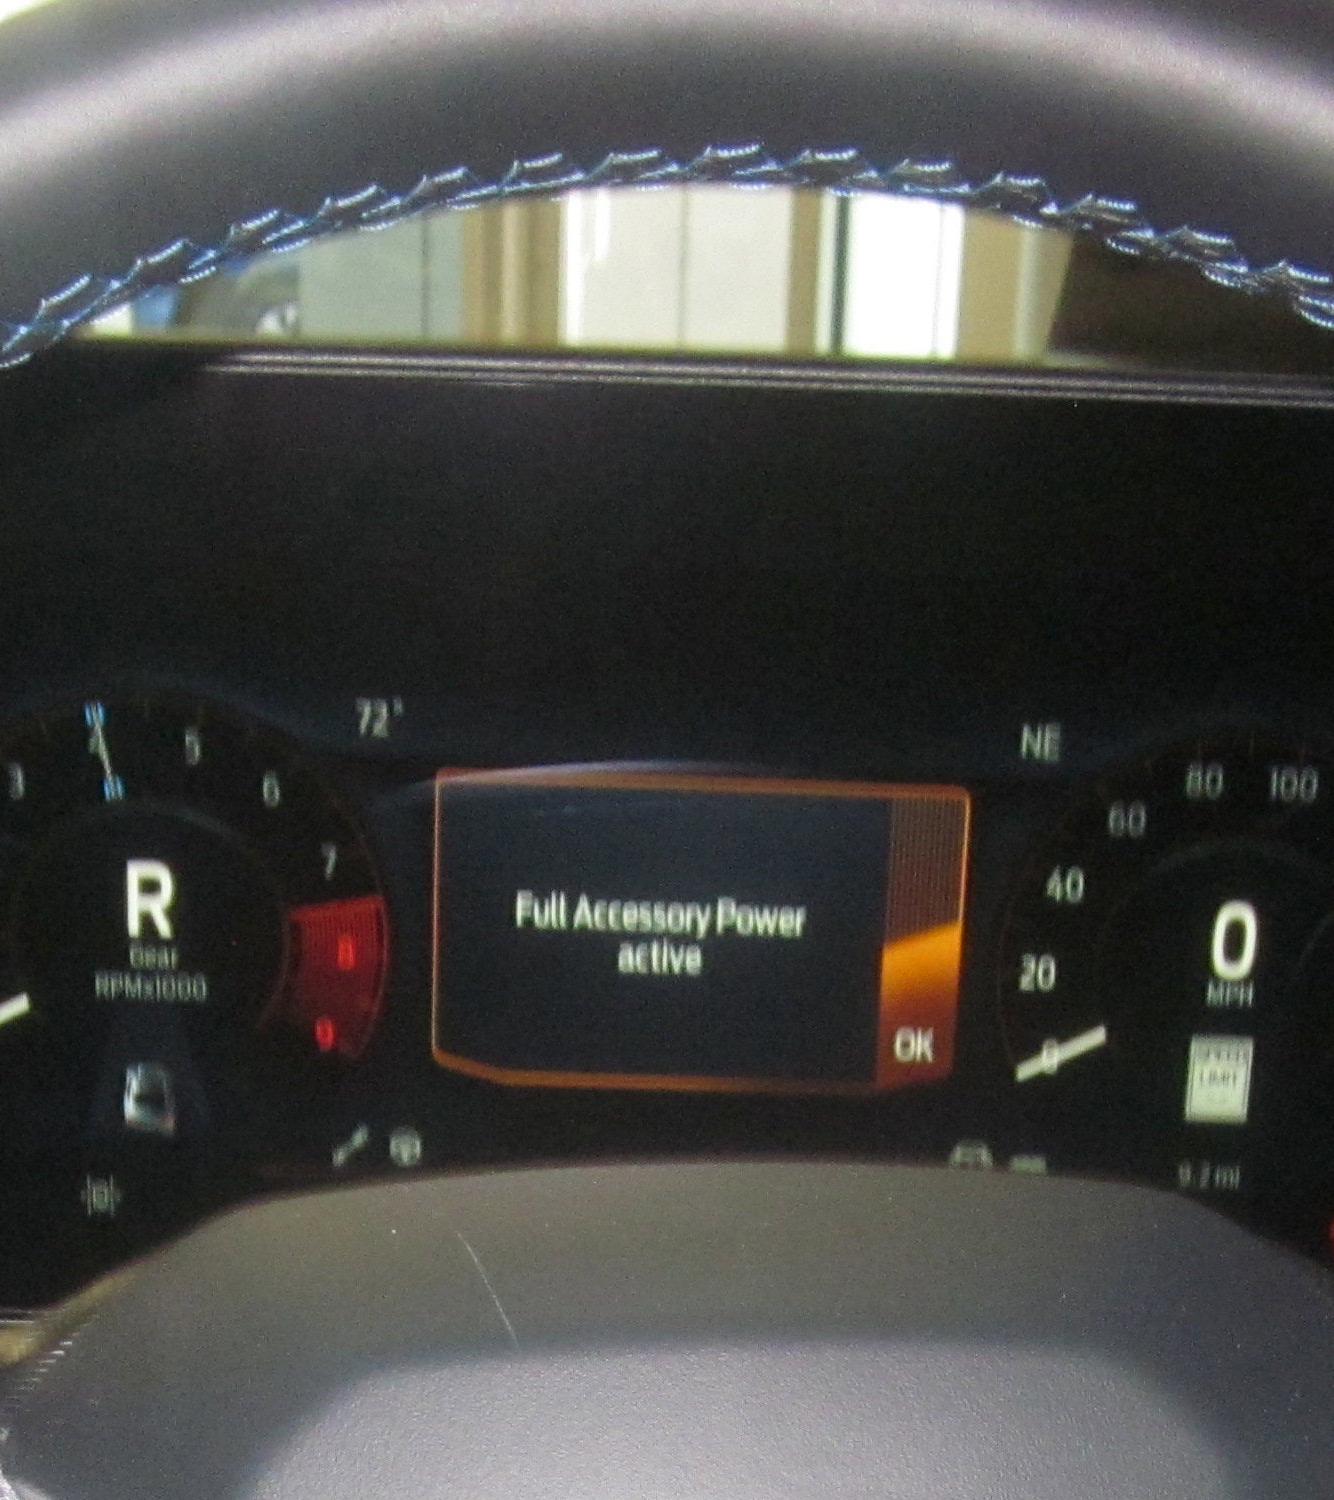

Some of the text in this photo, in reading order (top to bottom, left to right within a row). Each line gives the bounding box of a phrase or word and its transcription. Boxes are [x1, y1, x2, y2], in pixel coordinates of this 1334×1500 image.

[1019, 723, 1062, 764] NE
[1270, 765, 1319, 802] 100
[126, 859, 174, 939] R
[1045, 865, 1085, 902] 40
[516, 889, 806, 941] Full Accessory Power
[618, 941, 703, 976] active
[1211, 900, 1258, 981] 0
[1019, 952, 1058, 994] 20
[1207, 979, 1255, 1009] MPH
[894, 1025, 935, 1064] OK
